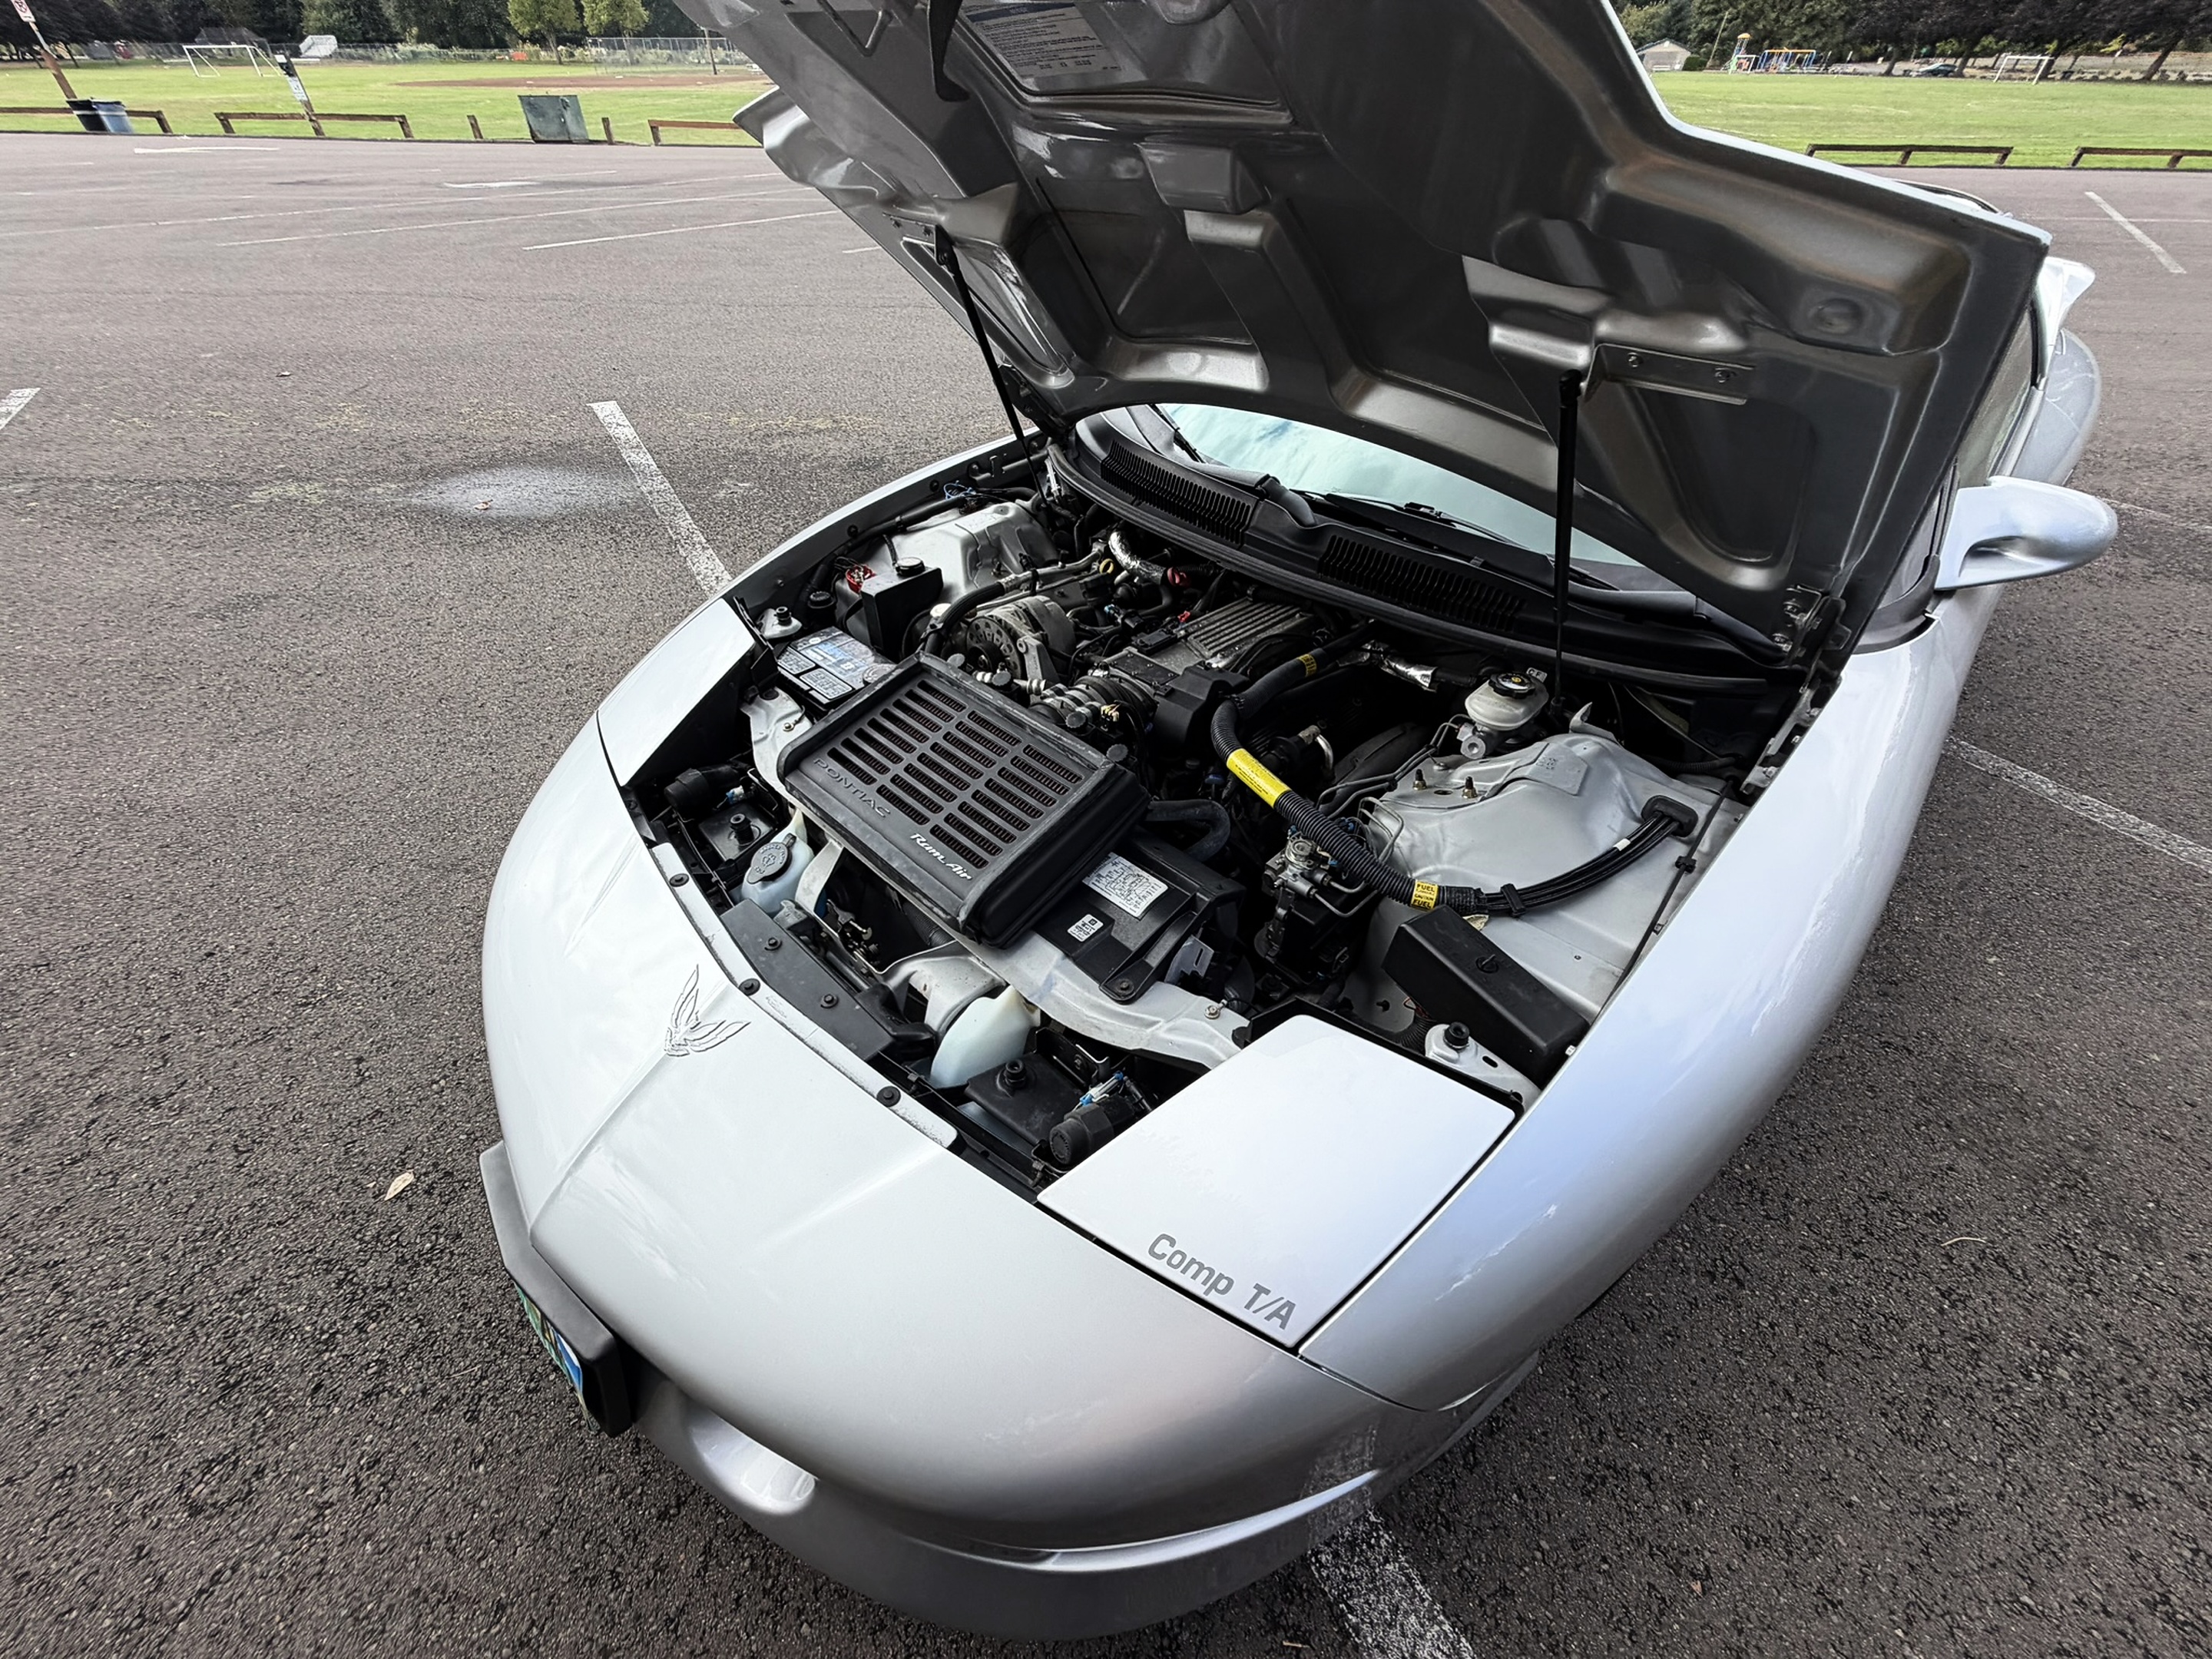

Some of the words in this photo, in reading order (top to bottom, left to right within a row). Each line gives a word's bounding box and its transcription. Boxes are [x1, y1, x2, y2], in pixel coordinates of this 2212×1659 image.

[813, 758, 891, 818] PONTIAC
[910, 833, 945, 865] Ram
[943, 862, 973, 881] Air
[1412, 899, 1431, 908] FUEL
[1417, 883, 1435, 892] FUEL
[1147, 1233, 1234, 1296] Comp
[1243, 1283, 1296, 1330] T/A
